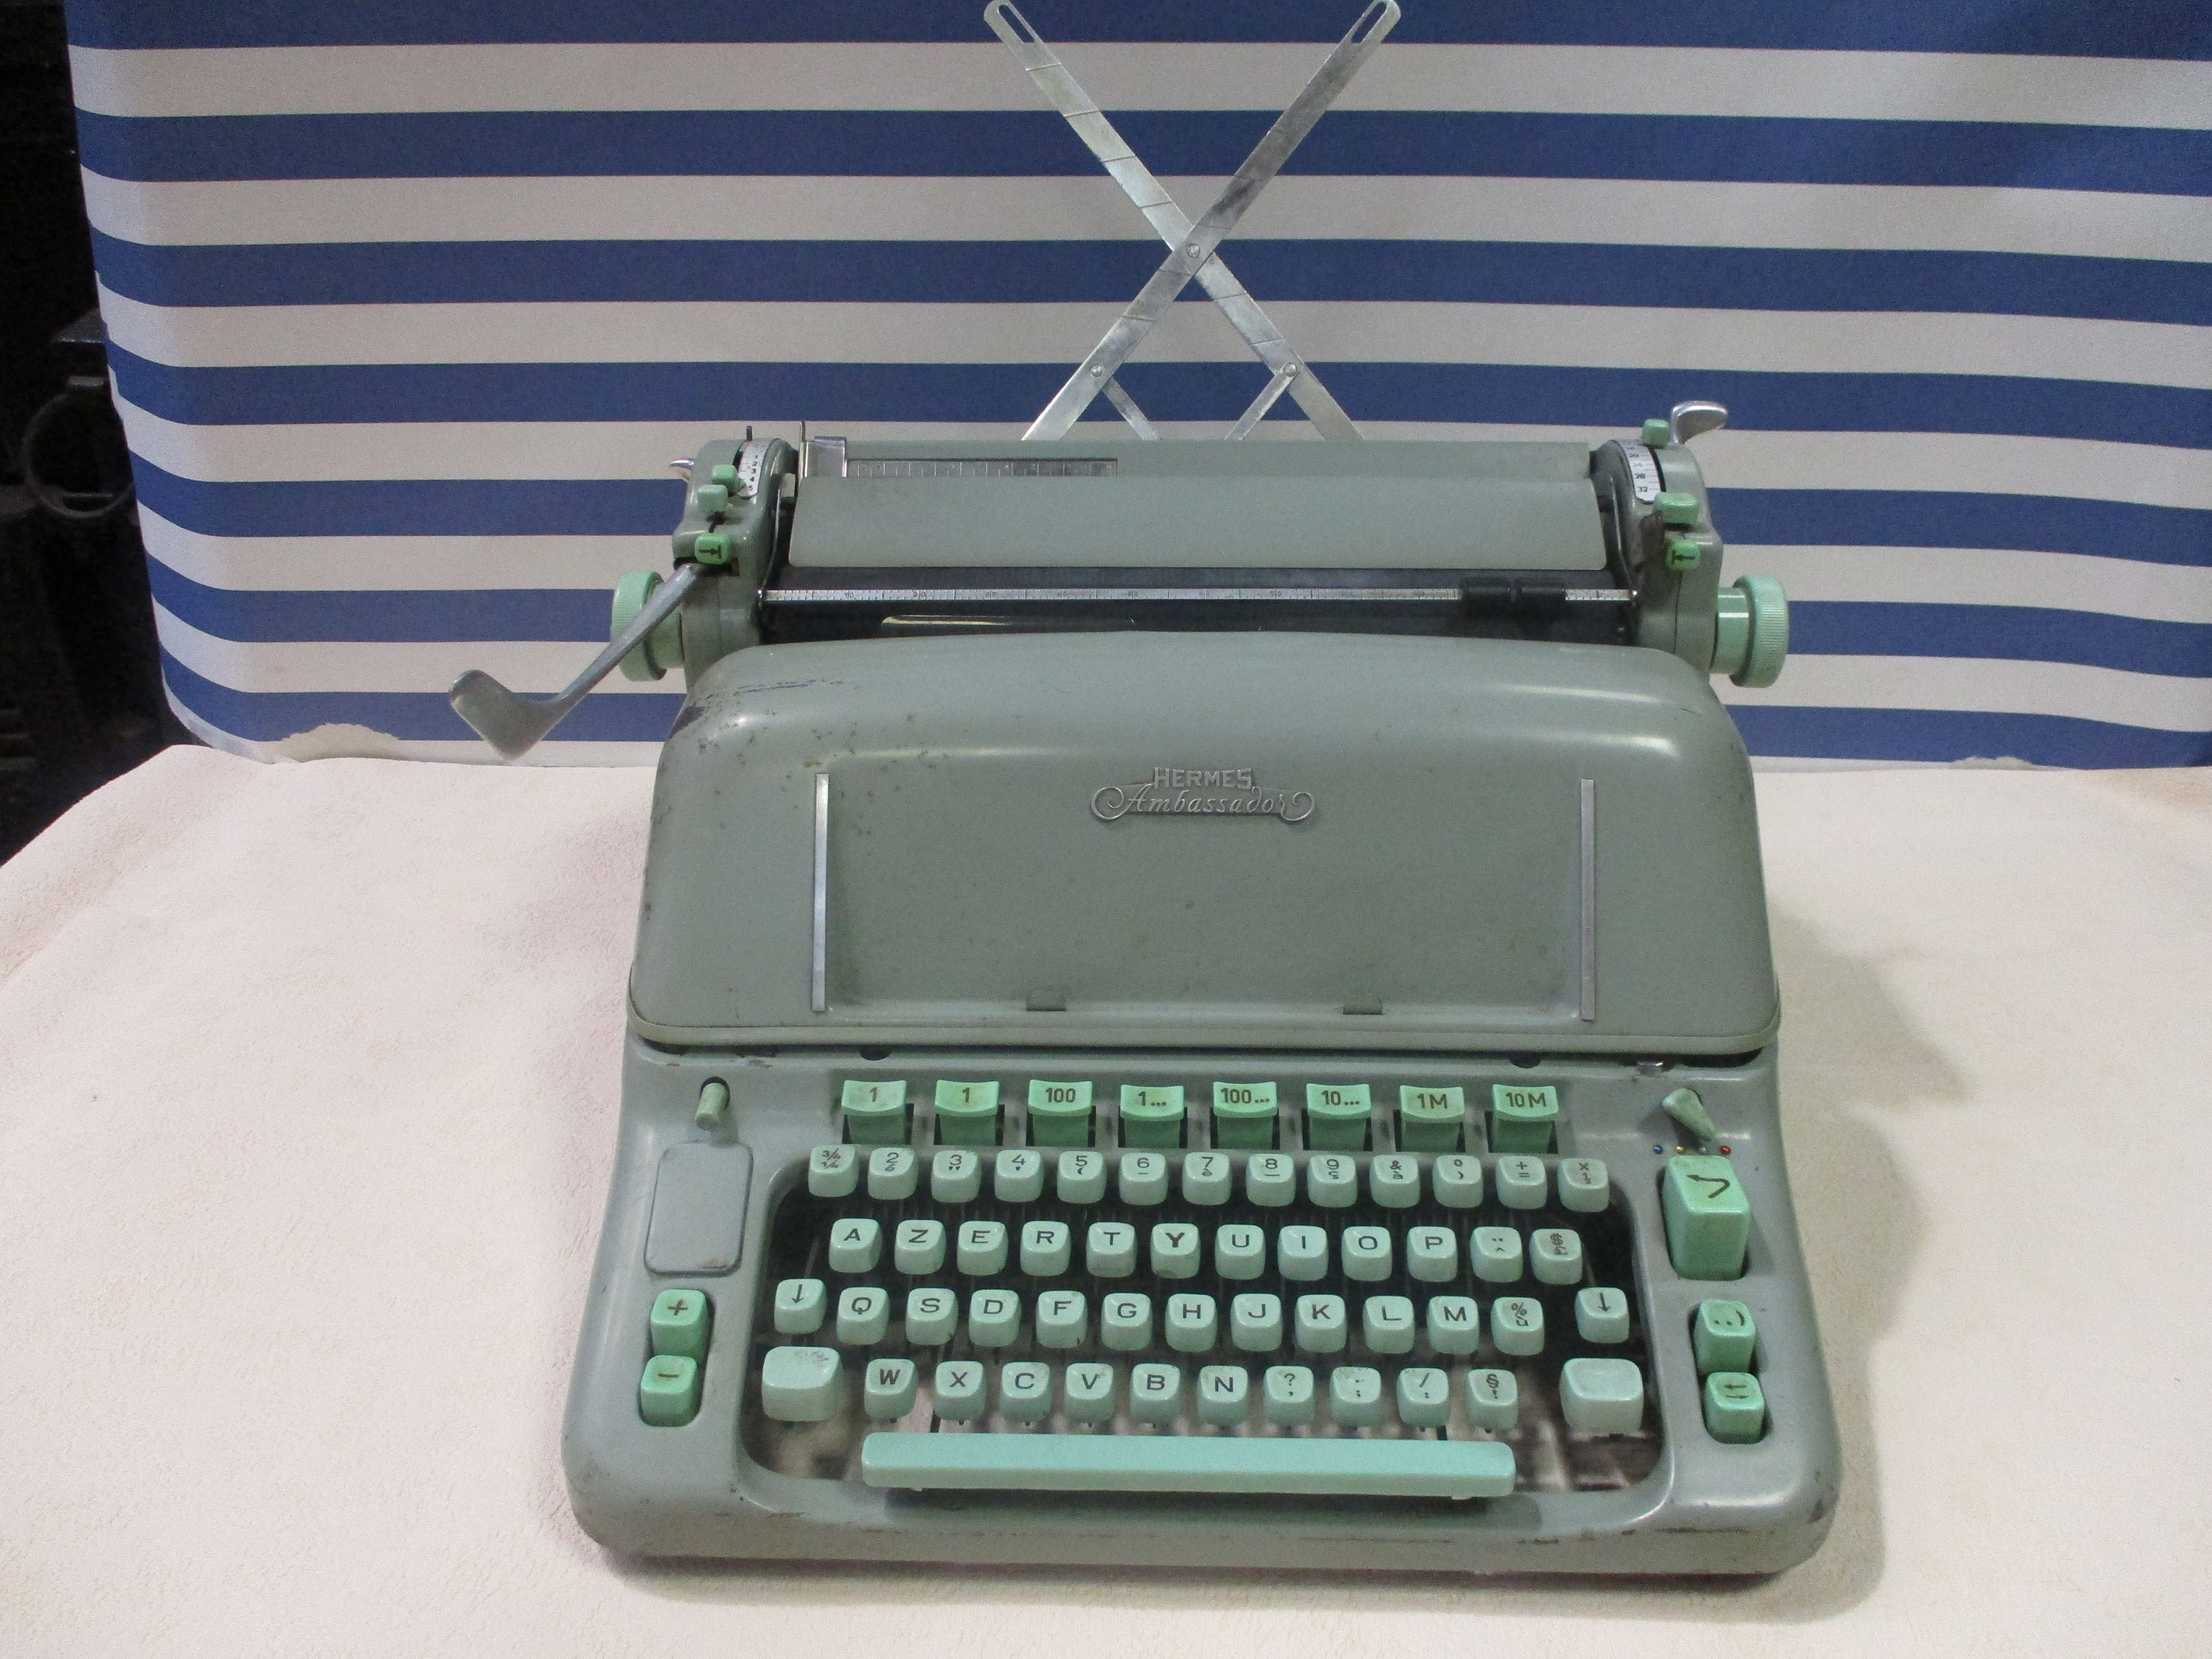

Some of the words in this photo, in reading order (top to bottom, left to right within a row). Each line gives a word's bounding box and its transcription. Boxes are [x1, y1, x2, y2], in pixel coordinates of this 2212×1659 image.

[1153, 767, 1252, 790] HERMES
[1091, 783, 1315, 821] Ambassador
[869, 1086, 878, 1102] 1
[961, 1087, 970, 1103] 1
[1045, 1087, 1076, 1104] 100
[886, 1152, 900, 1164] 2
[949, 1154, 962, 1166] 3
[1012, 1154, 1026, 1166] 4
[1075, 1155, 1088, 1167] 5
[1137, 1157, 1150, 1169] 6
[1201, 1156, 1214, 1169] 7
[1265, 1158, 1278, 1170] 8
[1326, 1158, 1340, 1171] 9
[844, 1228, 860, 1242] A
[908, 1228, 928, 1244] Z
[971, 1230, 990, 1244] E
[1036, 1231, 1055, 1245] R
[1103, 1231, 1121, 1246] T
[1165, 1232, 1185, 1248] Y
[1231, 1234, 1250, 1248] U
[1301, 1235, 1307, 1250] I
[1357, 1235, 1378, 1251] O
[1425, 1236, 1443, 1250] P
[851, 1296, 872, 1315] Q
[919, 1297, 941, 1313] S
[983, 1298, 1004, 1315] D
[1054, 1301, 1072, 1315] F
[1117, 1302, 1137, 1319] G
[1182, 1304, 1201, 1319] H
[1248, 1304, 1267, 1318] J
[1312, 1304, 1330, 1320] K
[1381, 1306, 1402, 1321] L
[1443, 1306, 1467, 1322] M
[880, 1368, 901, 1385] W
[950, 1371, 968, 1388] X
[1015, 1372, 1035, 1390] C
[1081, 1374, 1099, 1390] V
[1147, 1374, 1165, 1391] B
[1214, 1376, 1234, 1393] N
